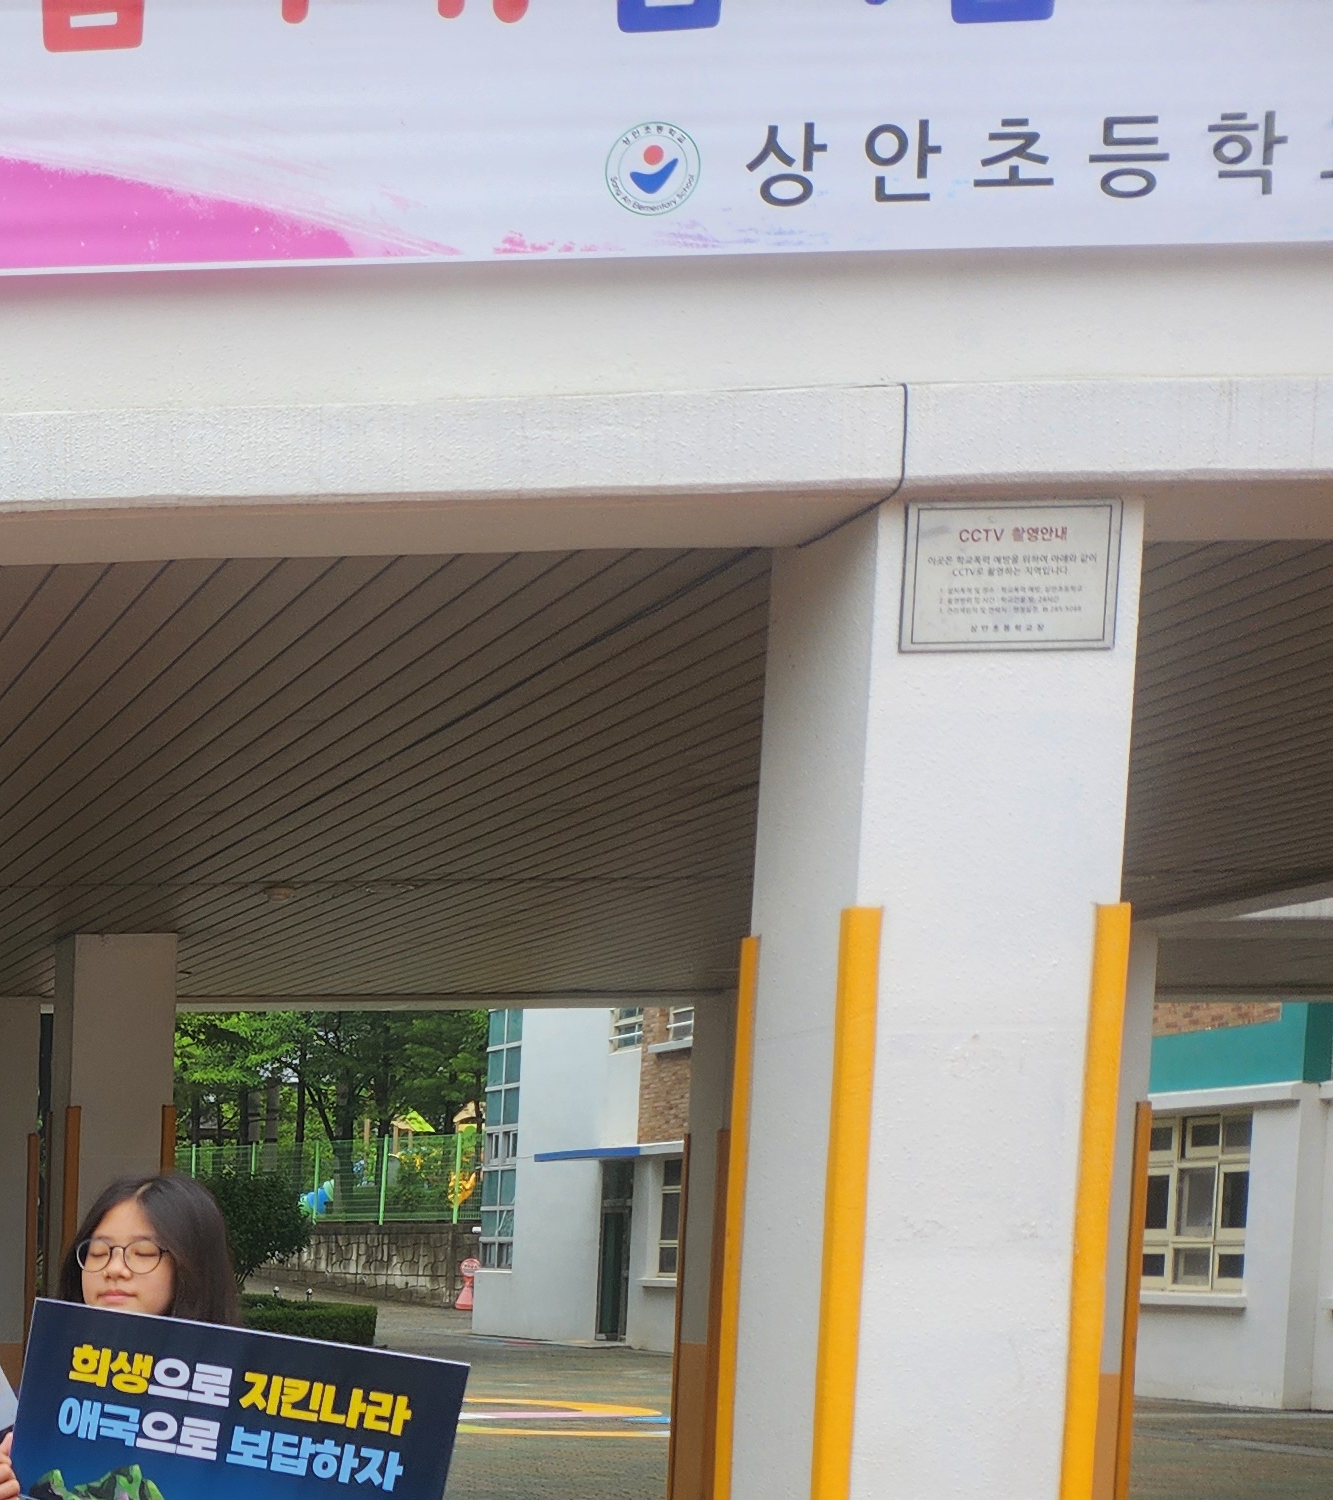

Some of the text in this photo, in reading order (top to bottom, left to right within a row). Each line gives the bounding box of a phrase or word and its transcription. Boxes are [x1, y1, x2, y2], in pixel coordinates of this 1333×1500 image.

[745, 110, 1333, 208] 상안초등학
[958, 526, 1068, 543] CCTV 촬영안내
[68, 1342, 414, 1437] 희생으로 지킨나라
[57, 1396, 405, 1494] 애국으로 보답하자
